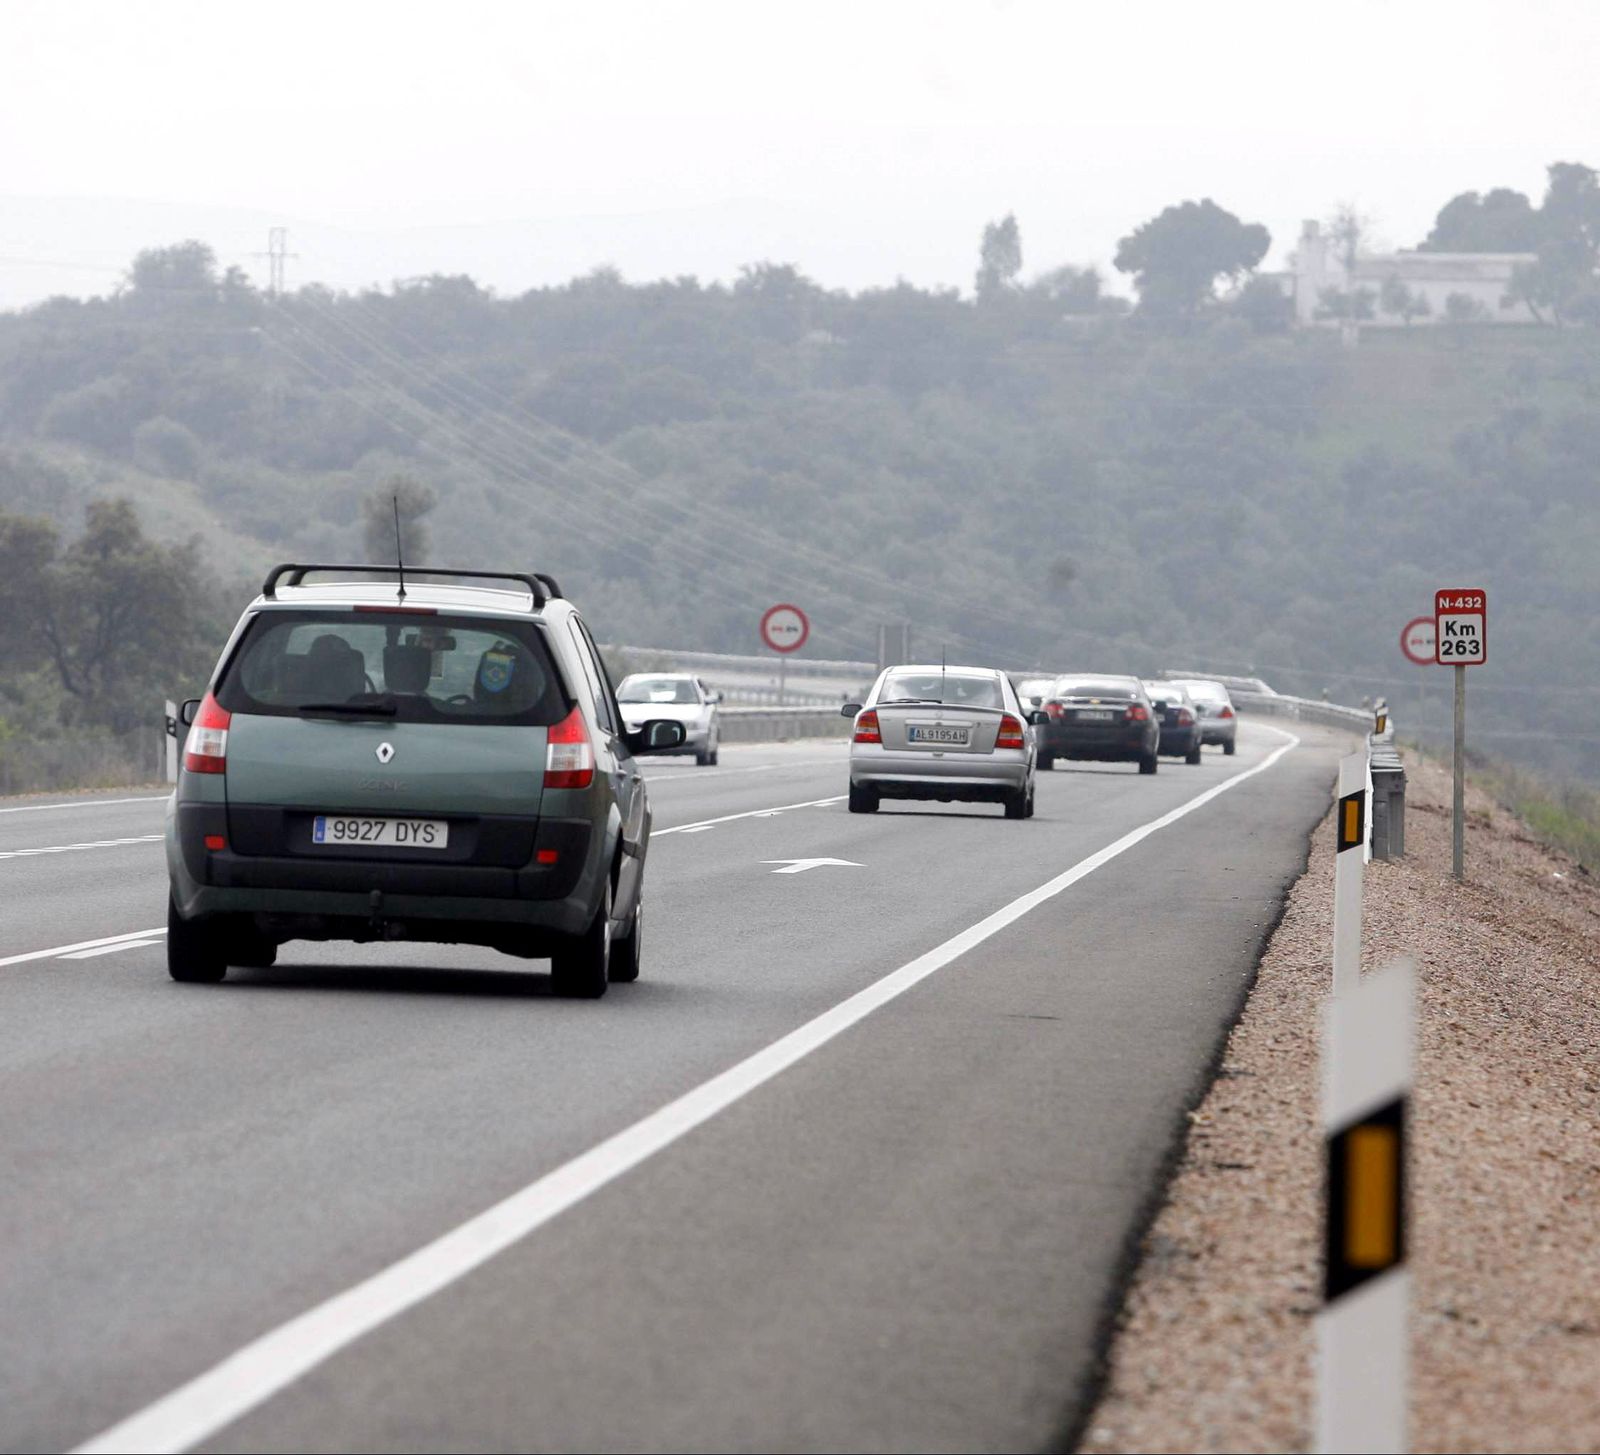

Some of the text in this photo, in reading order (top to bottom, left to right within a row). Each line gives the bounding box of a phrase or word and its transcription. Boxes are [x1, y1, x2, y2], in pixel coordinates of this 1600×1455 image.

[1439, 596, 1482, 609] N-432
[1445, 620, 1476, 636] Km
[1441, 640, 1480, 655] 263
[333, 820, 435, 843] 9927 DYS
